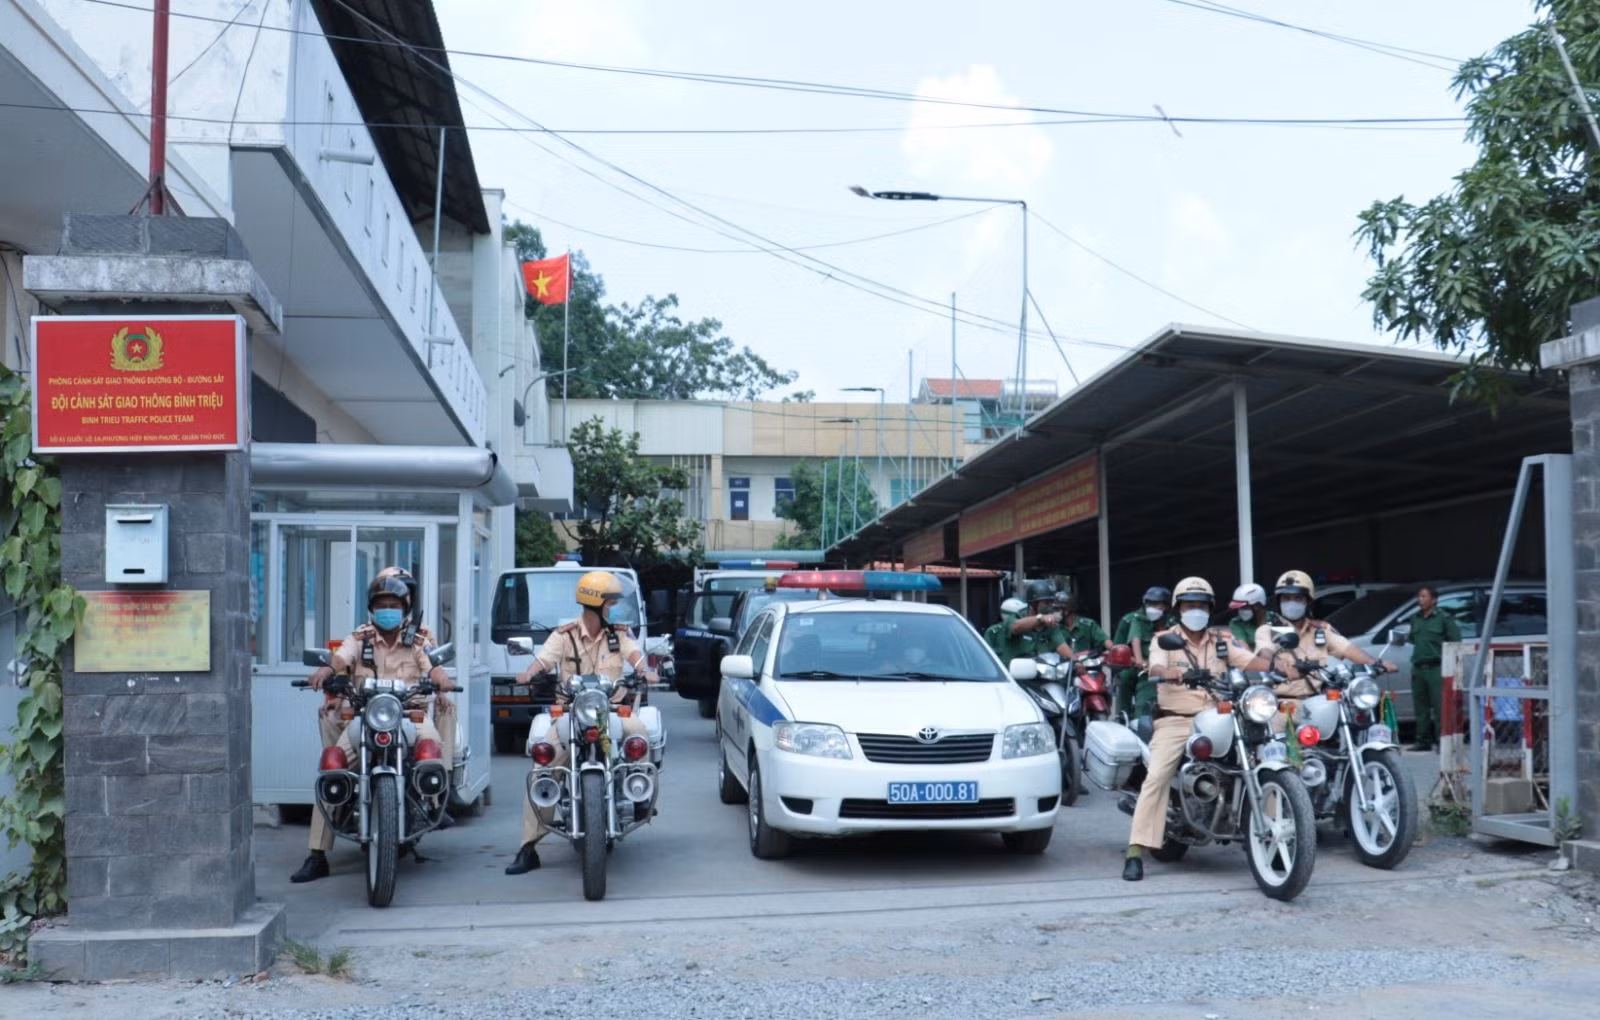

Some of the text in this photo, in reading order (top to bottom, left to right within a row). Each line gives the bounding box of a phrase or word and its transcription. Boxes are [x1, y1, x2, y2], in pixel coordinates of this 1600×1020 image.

[48, 376, 72, 385] PHÒNG
[93, 375, 104, 385] SÁT
[105, 376, 121, 385] GIAO
[122, 375, 146, 385] THÔNG
[51, 391, 224, 412] ĐỘI CẢNH SÁT GIAO THÔNG BÌNH TRIỆU
[81, 415, 194, 424] BINH TRIEU TRAFFIC POLICE TEAM
[890, 783, 976, 801] 50A-000.81
